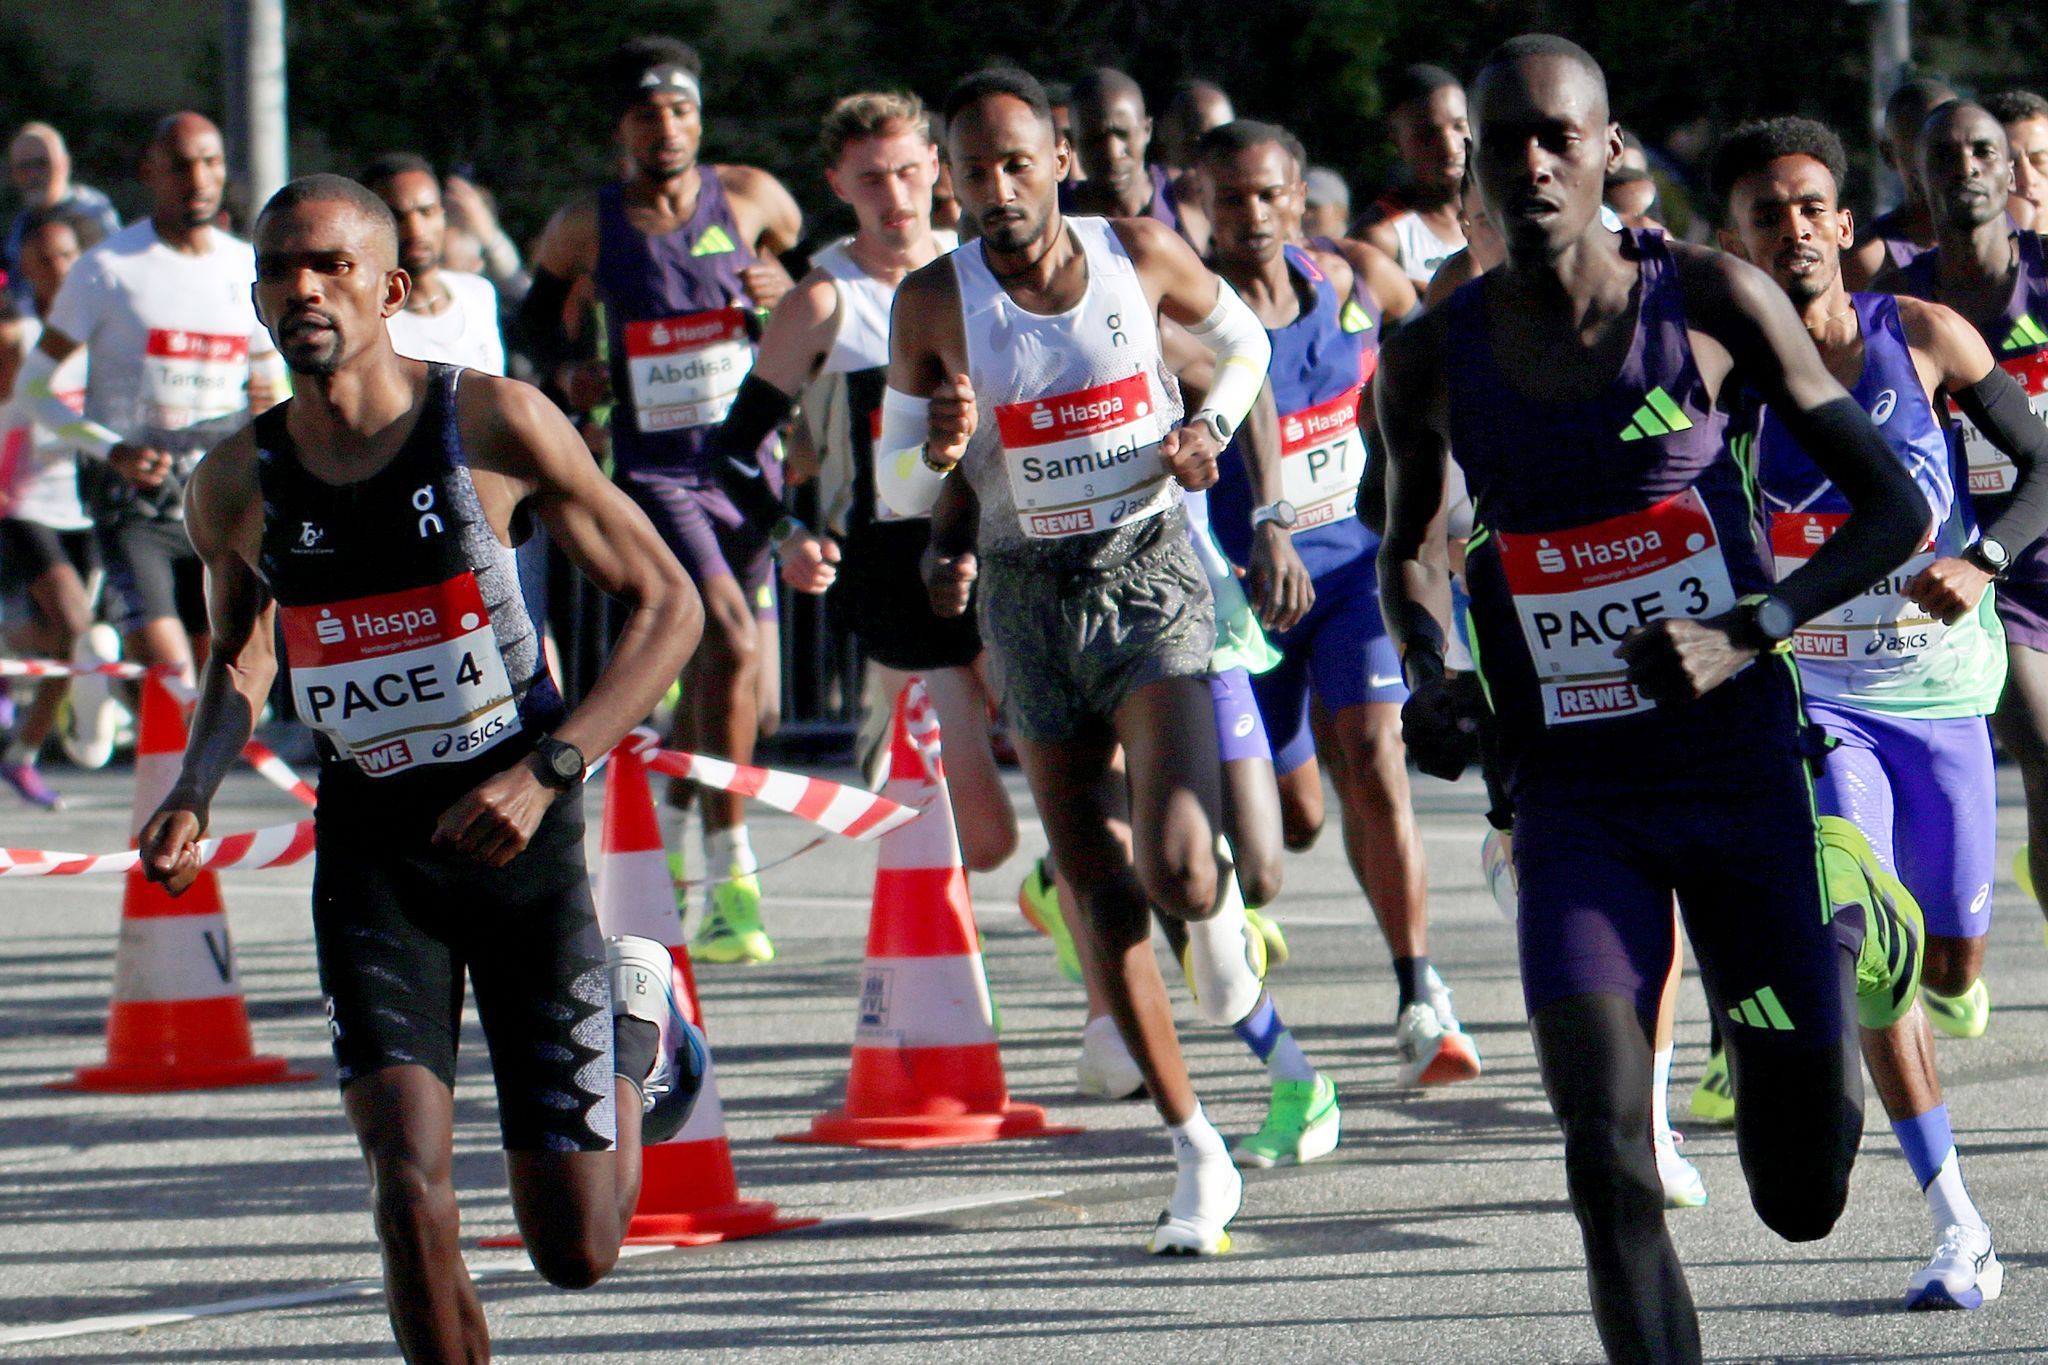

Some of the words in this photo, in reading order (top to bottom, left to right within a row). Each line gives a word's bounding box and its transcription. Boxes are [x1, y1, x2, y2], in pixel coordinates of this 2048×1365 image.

[648, 358, 732, 384] Abdisa
[1060, 397, 1123, 424] Haspa
[1307, 405, 1355, 434] Haspa
[1022, 434, 1139, 482] Samuel
[1307, 439, 1347, 483] P7
[1084, 484, 1095, 498] 3
[1033, 511, 1091, 534] REWE
[1571, 530, 1662, 569] Haspa
[352, 607, 437, 639] Haspa
[1533, 591, 1665, 650] PACE
[1679, 576, 1709, 616] 3
[1843, 608, 1854, 623] 2
[1886, 633, 1928, 651] asics
[306, 664, 446, 723] PACE
[456, 651, 484, 687] 4
[1560, 685, 1635, 714] REWE
[456, 715, 505, 752] asics
